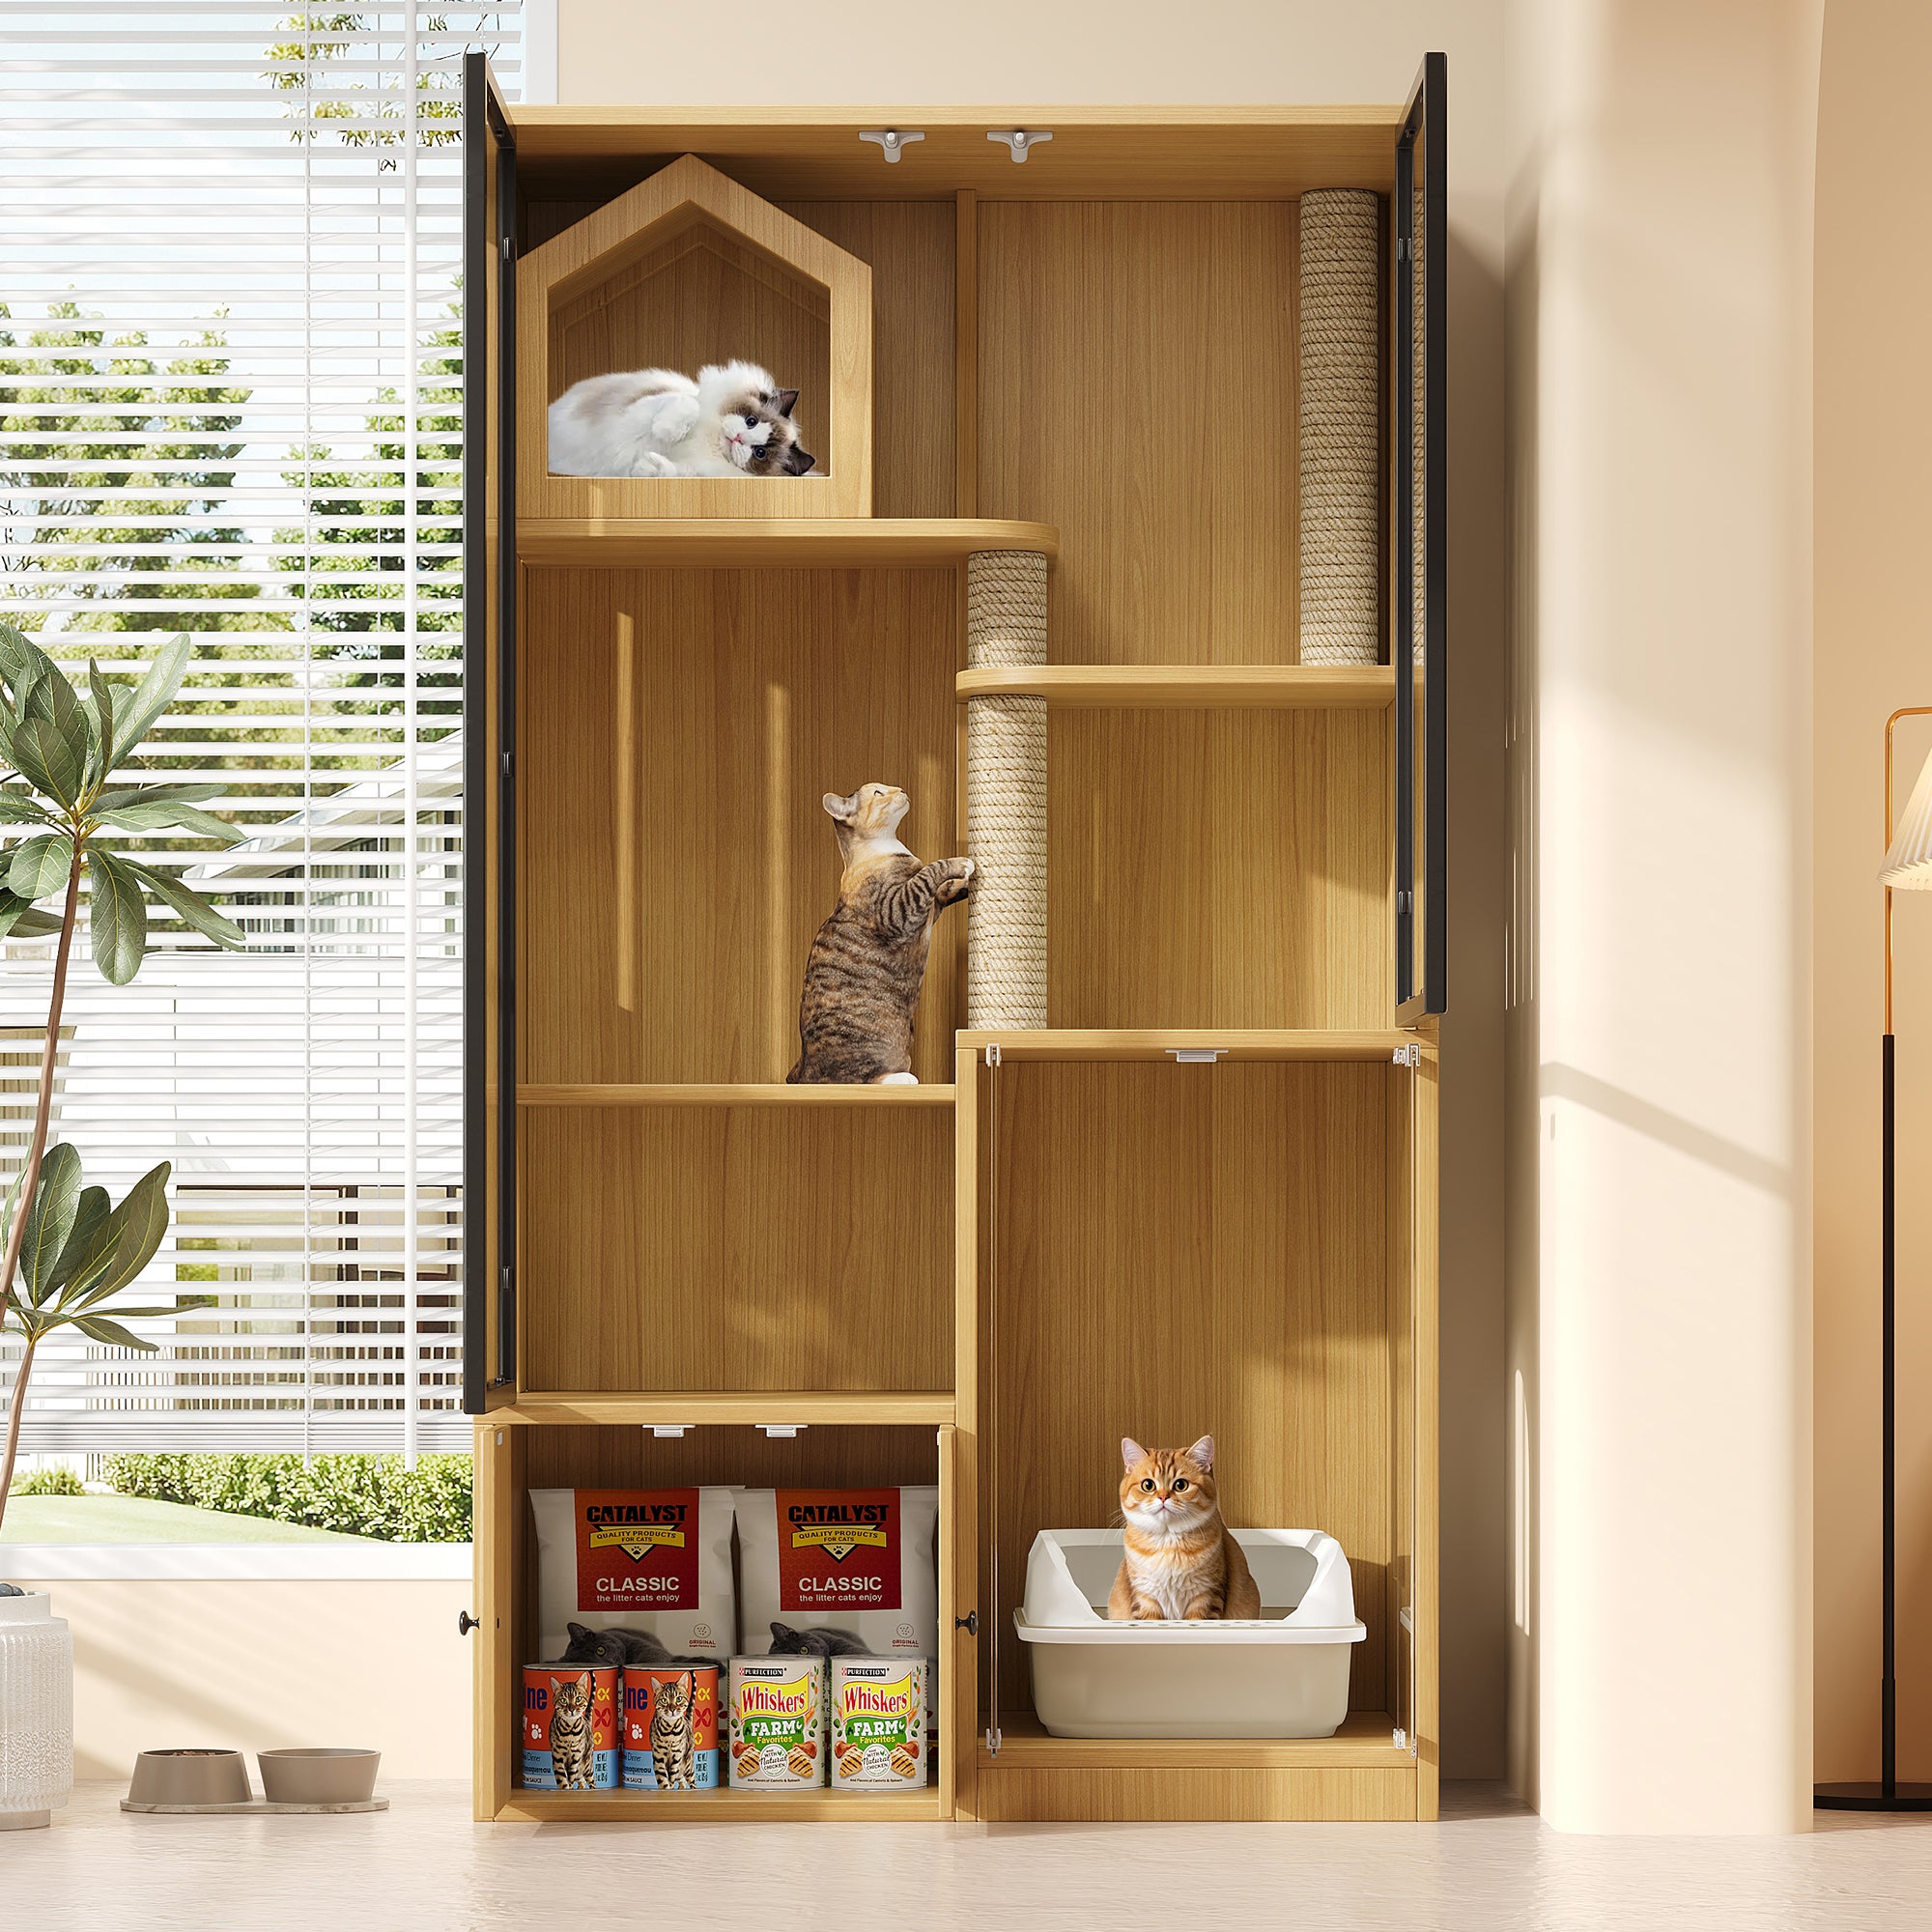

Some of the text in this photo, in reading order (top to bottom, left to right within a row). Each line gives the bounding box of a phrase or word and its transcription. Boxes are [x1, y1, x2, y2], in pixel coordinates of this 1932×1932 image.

[586, 1505, 688, 1522] CATALYST
[788, 1504, 889, 1522] CATALYST
[596, 1530, 677, 1540] QUALITY PRODUCTS
[799, 1530, 878, 1540] QUALITY PRODUCTS
[596, 1577, 680, 1592] CLASSIC
[798, 1577, 882, 1592] CLASSIC
[657, 1593, 680, 1603] enjoy
[859, 1593, 882, 1603] enjoy
[742, 1686, 805, 1713] Whiskers
[844, 1686, 907, 1713] Whiskers
[751, 1720, 796, 1737] FARM
[853, 1720, 898, 1737] FARM
[757, 1736, 793, 1745] Favorites
[860, 1736, 895, 1745] Favorites
[759, 1754, 788, 1766] Natural
[862, 1754, 891, 1766] Natural
